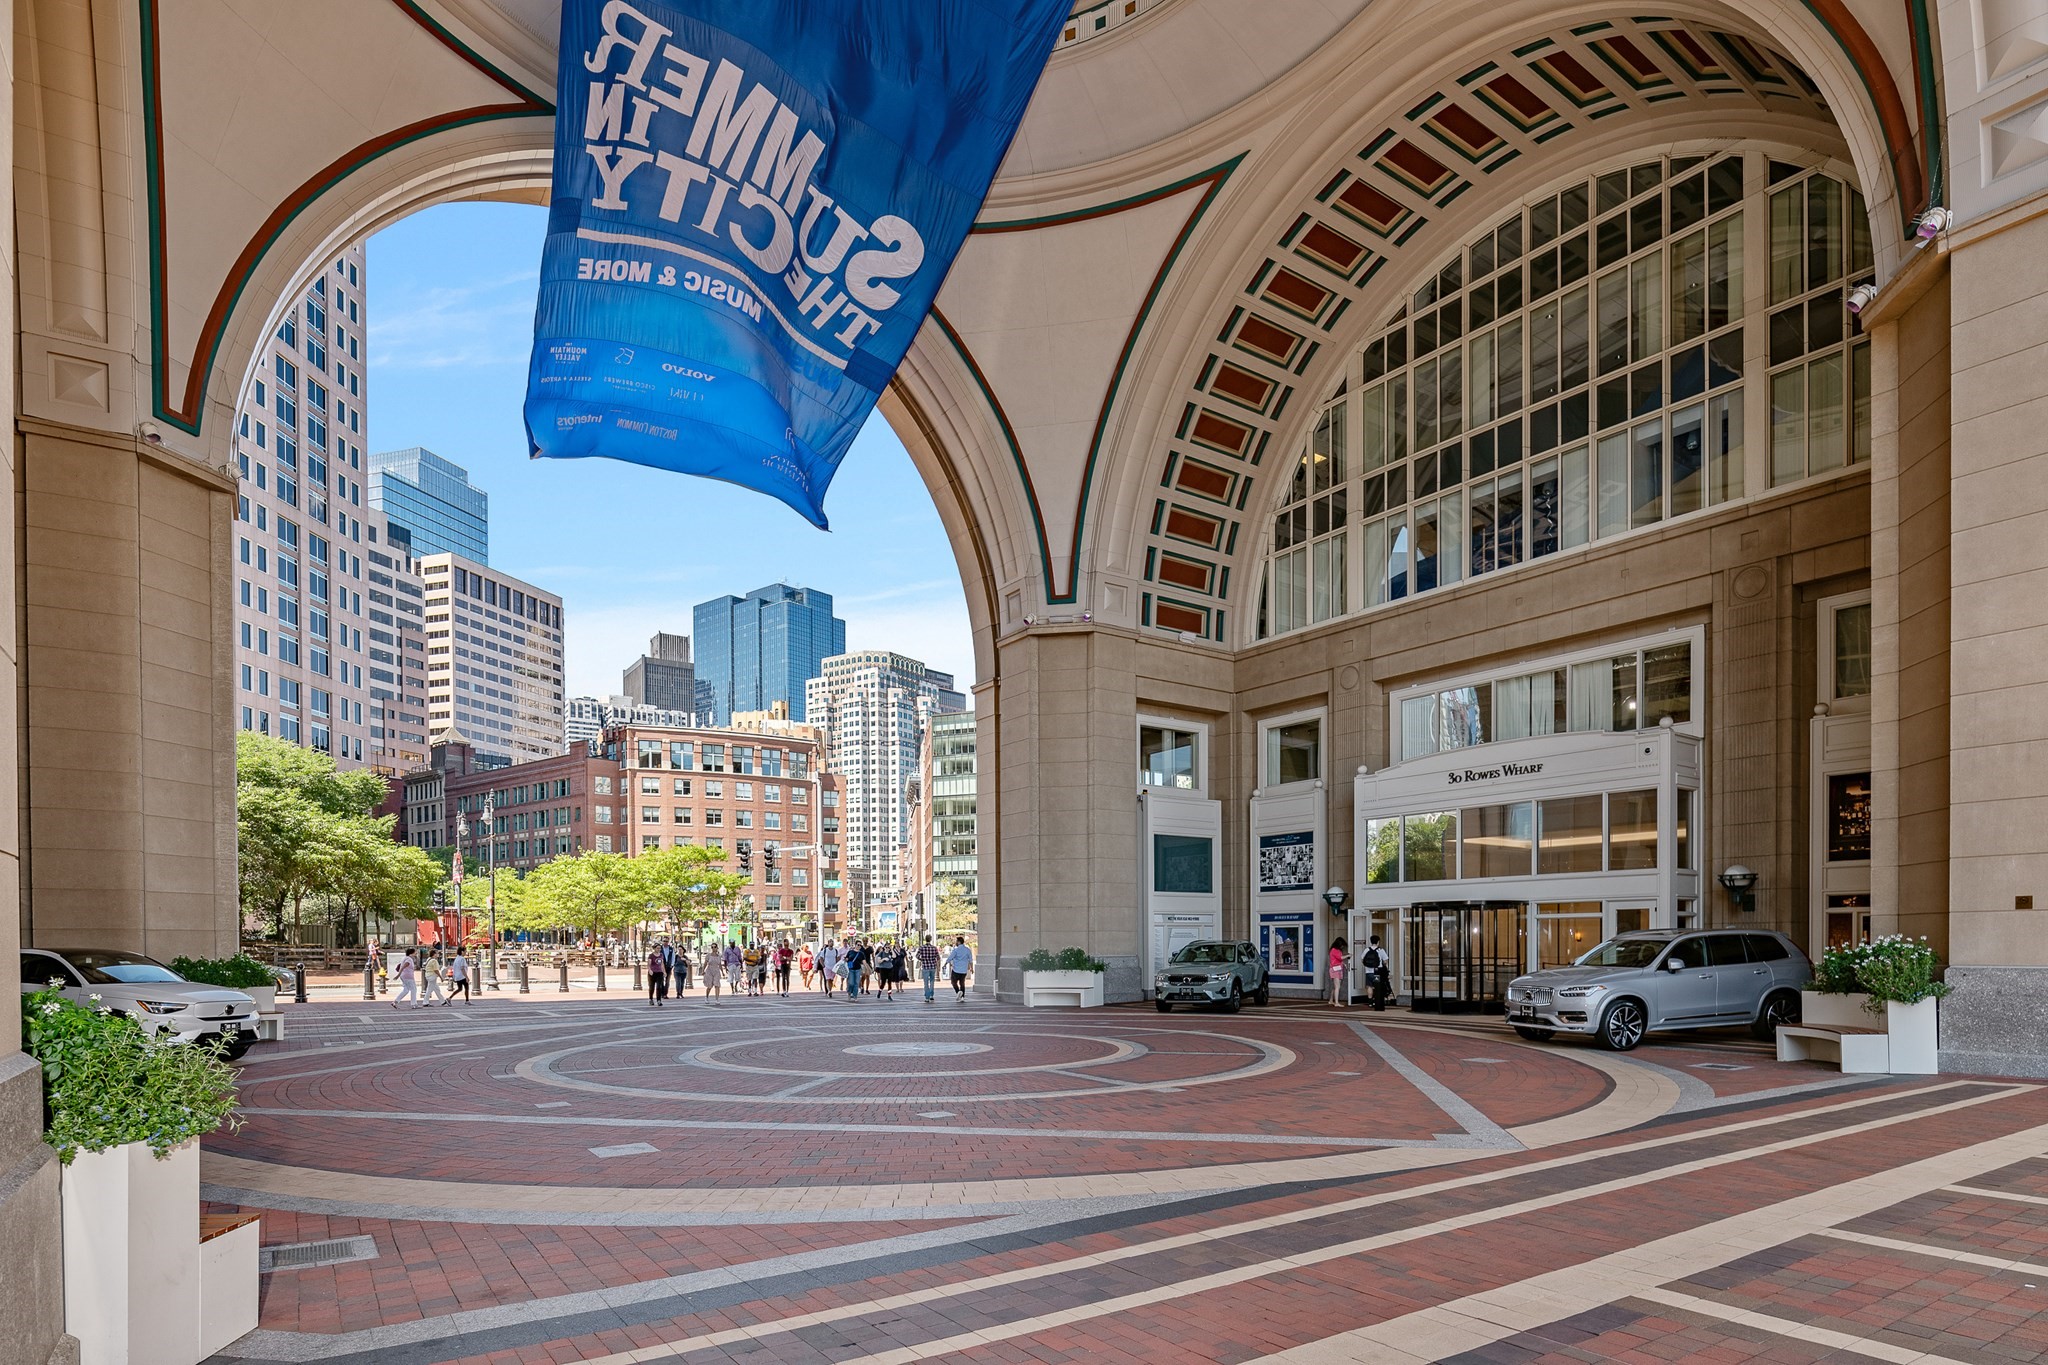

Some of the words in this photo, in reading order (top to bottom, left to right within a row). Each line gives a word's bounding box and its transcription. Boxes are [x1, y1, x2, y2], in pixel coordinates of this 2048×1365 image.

[1448, 772, 1462, 784] 30
[1464, 769, 1500, 782] ROWES
[1502, 763, 1543, 776] WHARF
